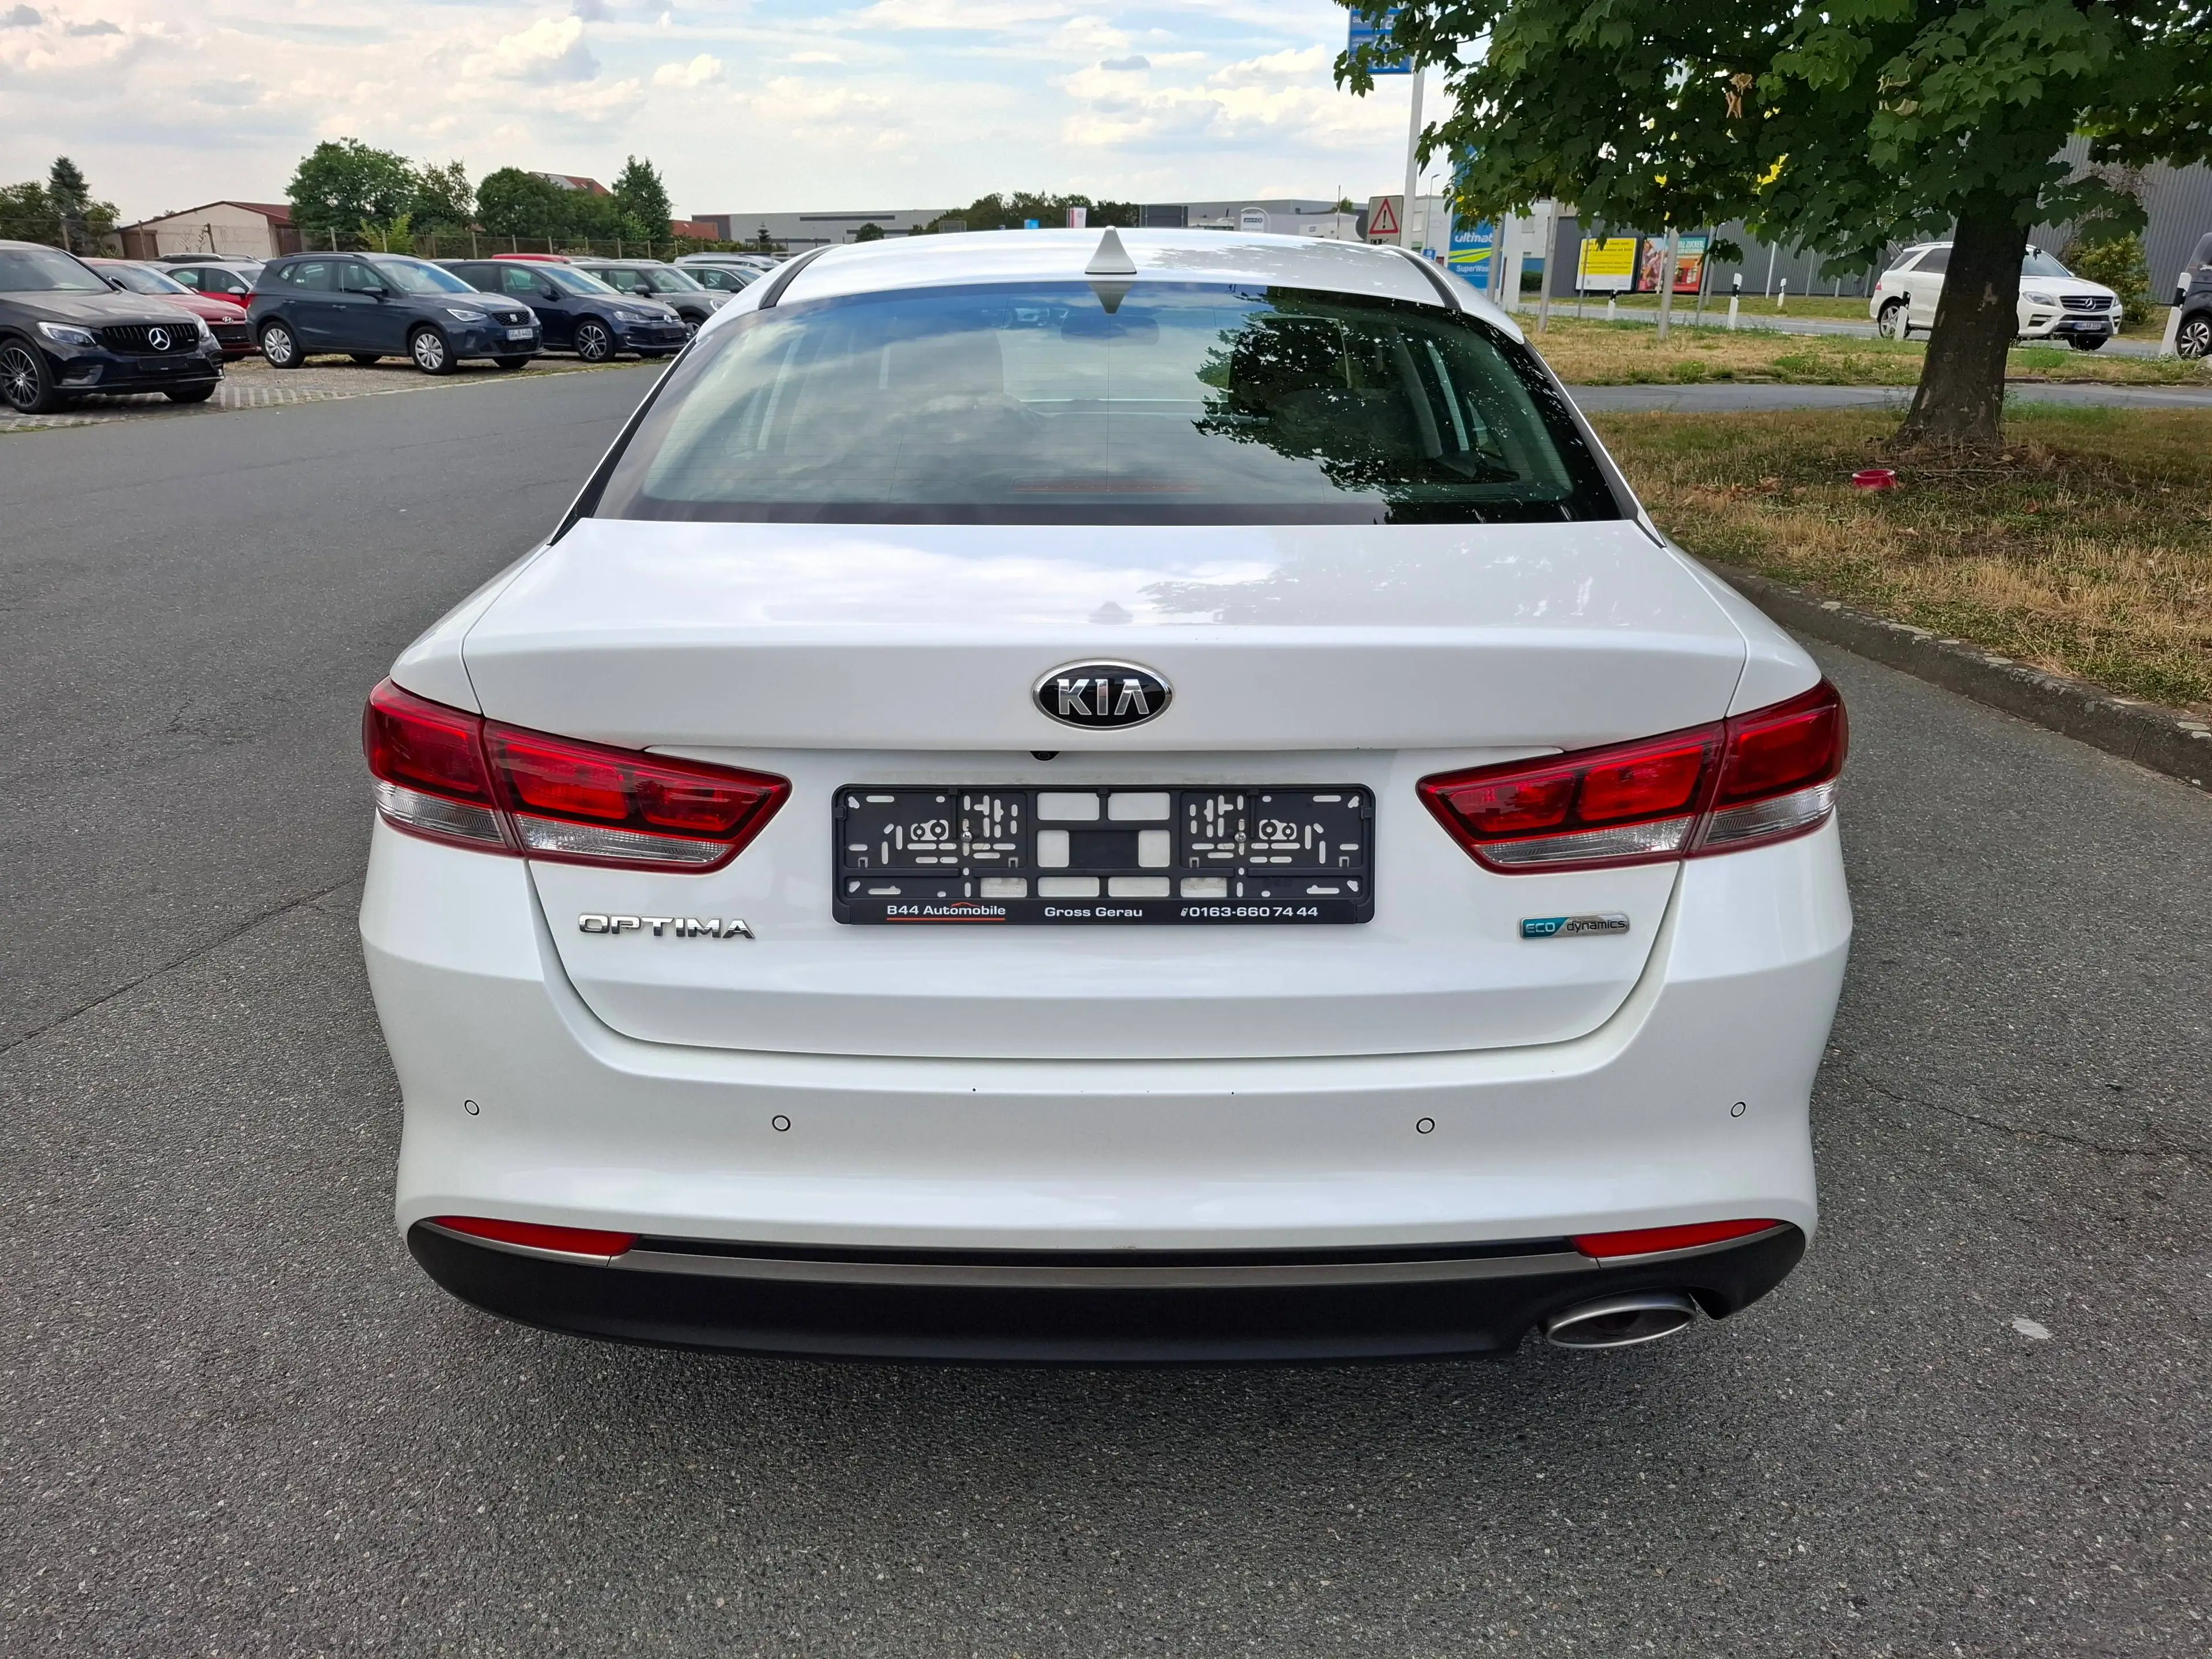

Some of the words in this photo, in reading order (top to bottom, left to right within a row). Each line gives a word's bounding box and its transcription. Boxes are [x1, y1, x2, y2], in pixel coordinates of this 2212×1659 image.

[1455, 232, 1493, 243] ultimat
[1456, 265, 1489, 273] SuperWas
[1057, 679, 1150, 715] KIA
[887, 906, 919, 915] B44
[923, 905, 1006, 915] Automobile
[1044, 907, 1091, 916] Gross
[1095, 907, 1142, 916] Gerau
[1190, 907, 1270, 916] 0163-660
[1272, 907, 1293, 916] 74
[1296, 907, 1318, 916] 44
[578, 914, 755, 938] OPTIMA
[1527, 922, 1555, 933] ECO
[1566, 919, 1626, 933] dynamics
